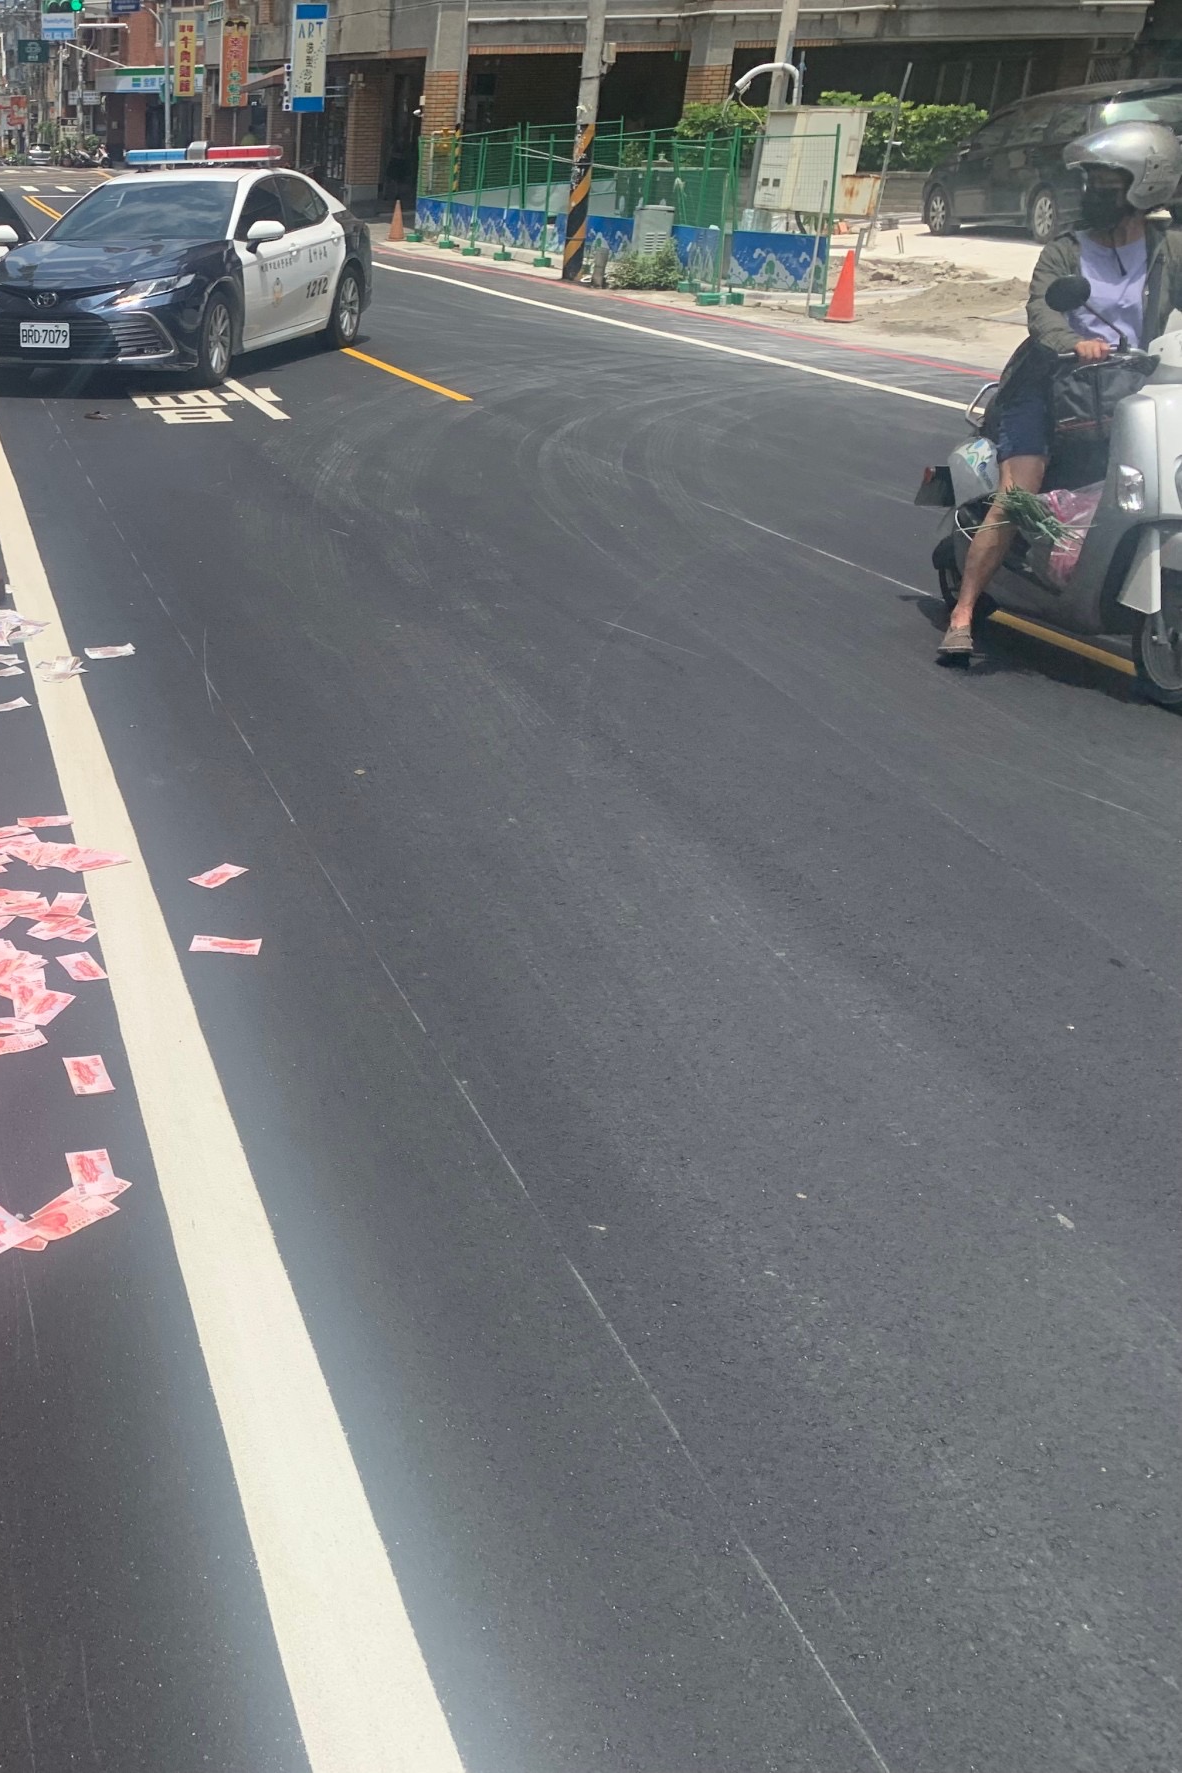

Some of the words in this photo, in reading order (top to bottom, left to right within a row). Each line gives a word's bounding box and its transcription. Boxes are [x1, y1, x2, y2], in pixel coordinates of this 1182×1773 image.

[298, 21, 324, 39] ART
[306, 277, 329, 299] 1212
[21, 328, 68, 344] BRD-7079
